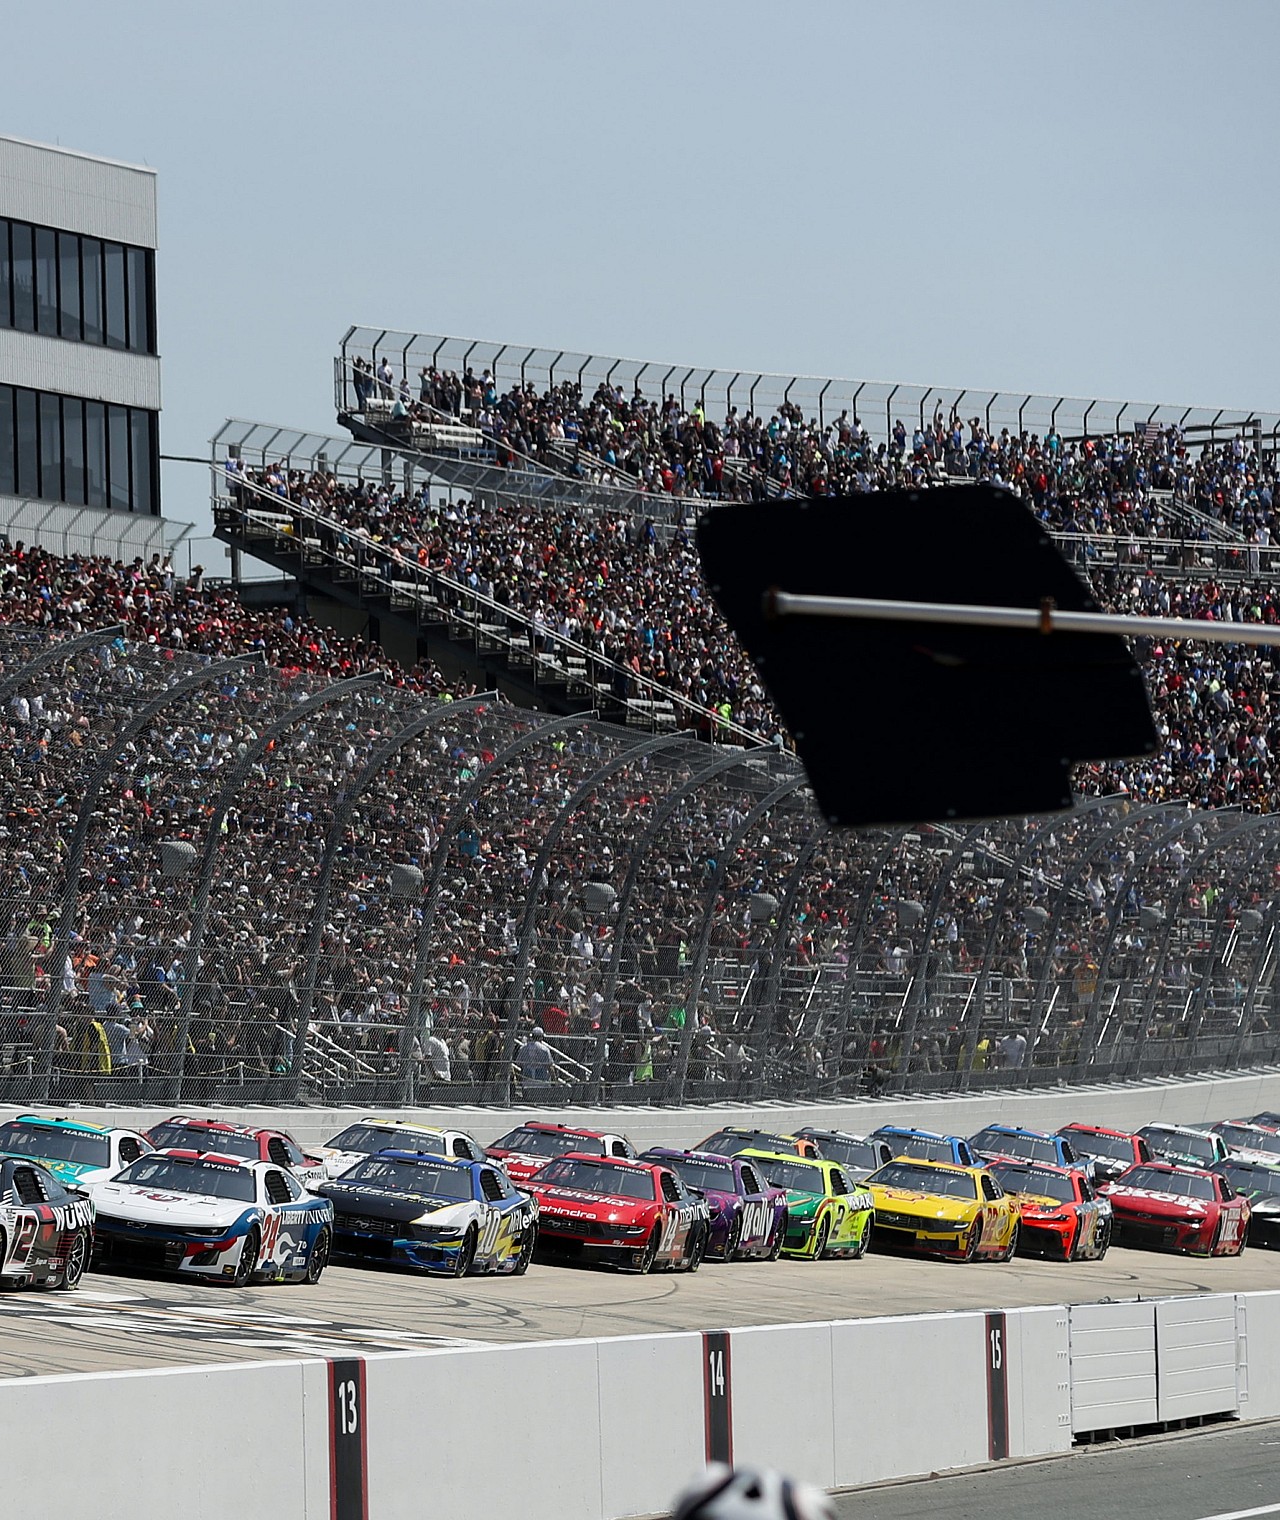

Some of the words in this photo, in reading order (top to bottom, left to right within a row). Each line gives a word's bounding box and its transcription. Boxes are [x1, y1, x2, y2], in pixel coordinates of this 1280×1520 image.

[62, 1129, 104, 1141] HAMLIN
[202, 1162, 240, 1173] BYRON
[417, 1161, 459, 1172] GRAGSON
[685, 1158, 726, 1169] BOWMAN
[1028, 1169, 1056, 1179] TRUEX
[539, 1206, 597, 1220] ahindra
[828, 1204, 845, 1240] 2
[259, 1213, 281, 1260] 24
[990, 1329, 1002, 1369] 15
[709, 1350, 725, 1397] 14
[338, 1380, 358, 1435] 13
